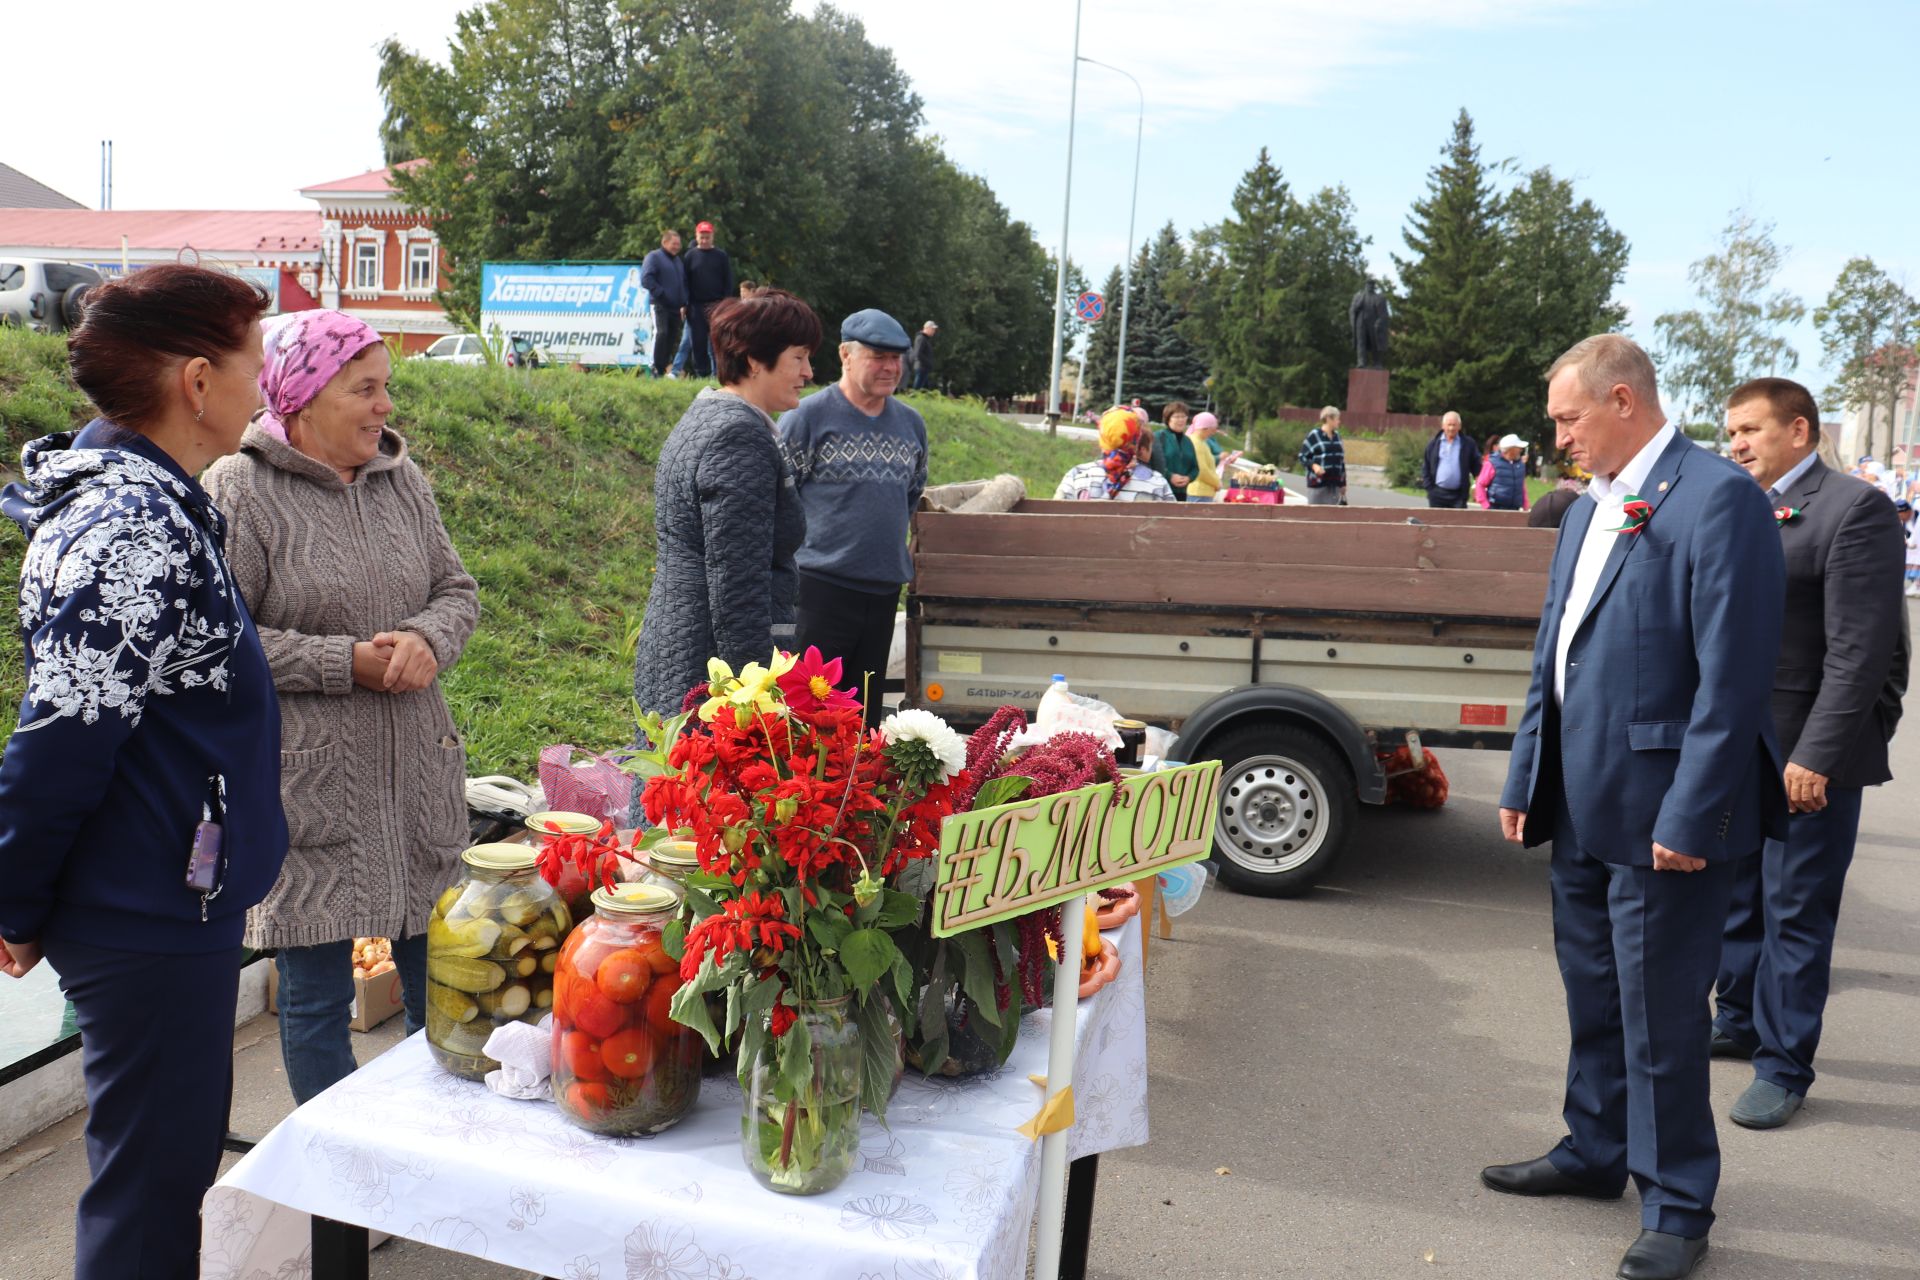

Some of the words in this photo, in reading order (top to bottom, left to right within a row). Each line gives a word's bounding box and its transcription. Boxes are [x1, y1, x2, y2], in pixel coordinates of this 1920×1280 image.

[489, 275, 614, 307] Хозтовары
[488, 322, 623, 348] струменты
[939, 766, 1223, 930] #БМСОШ
